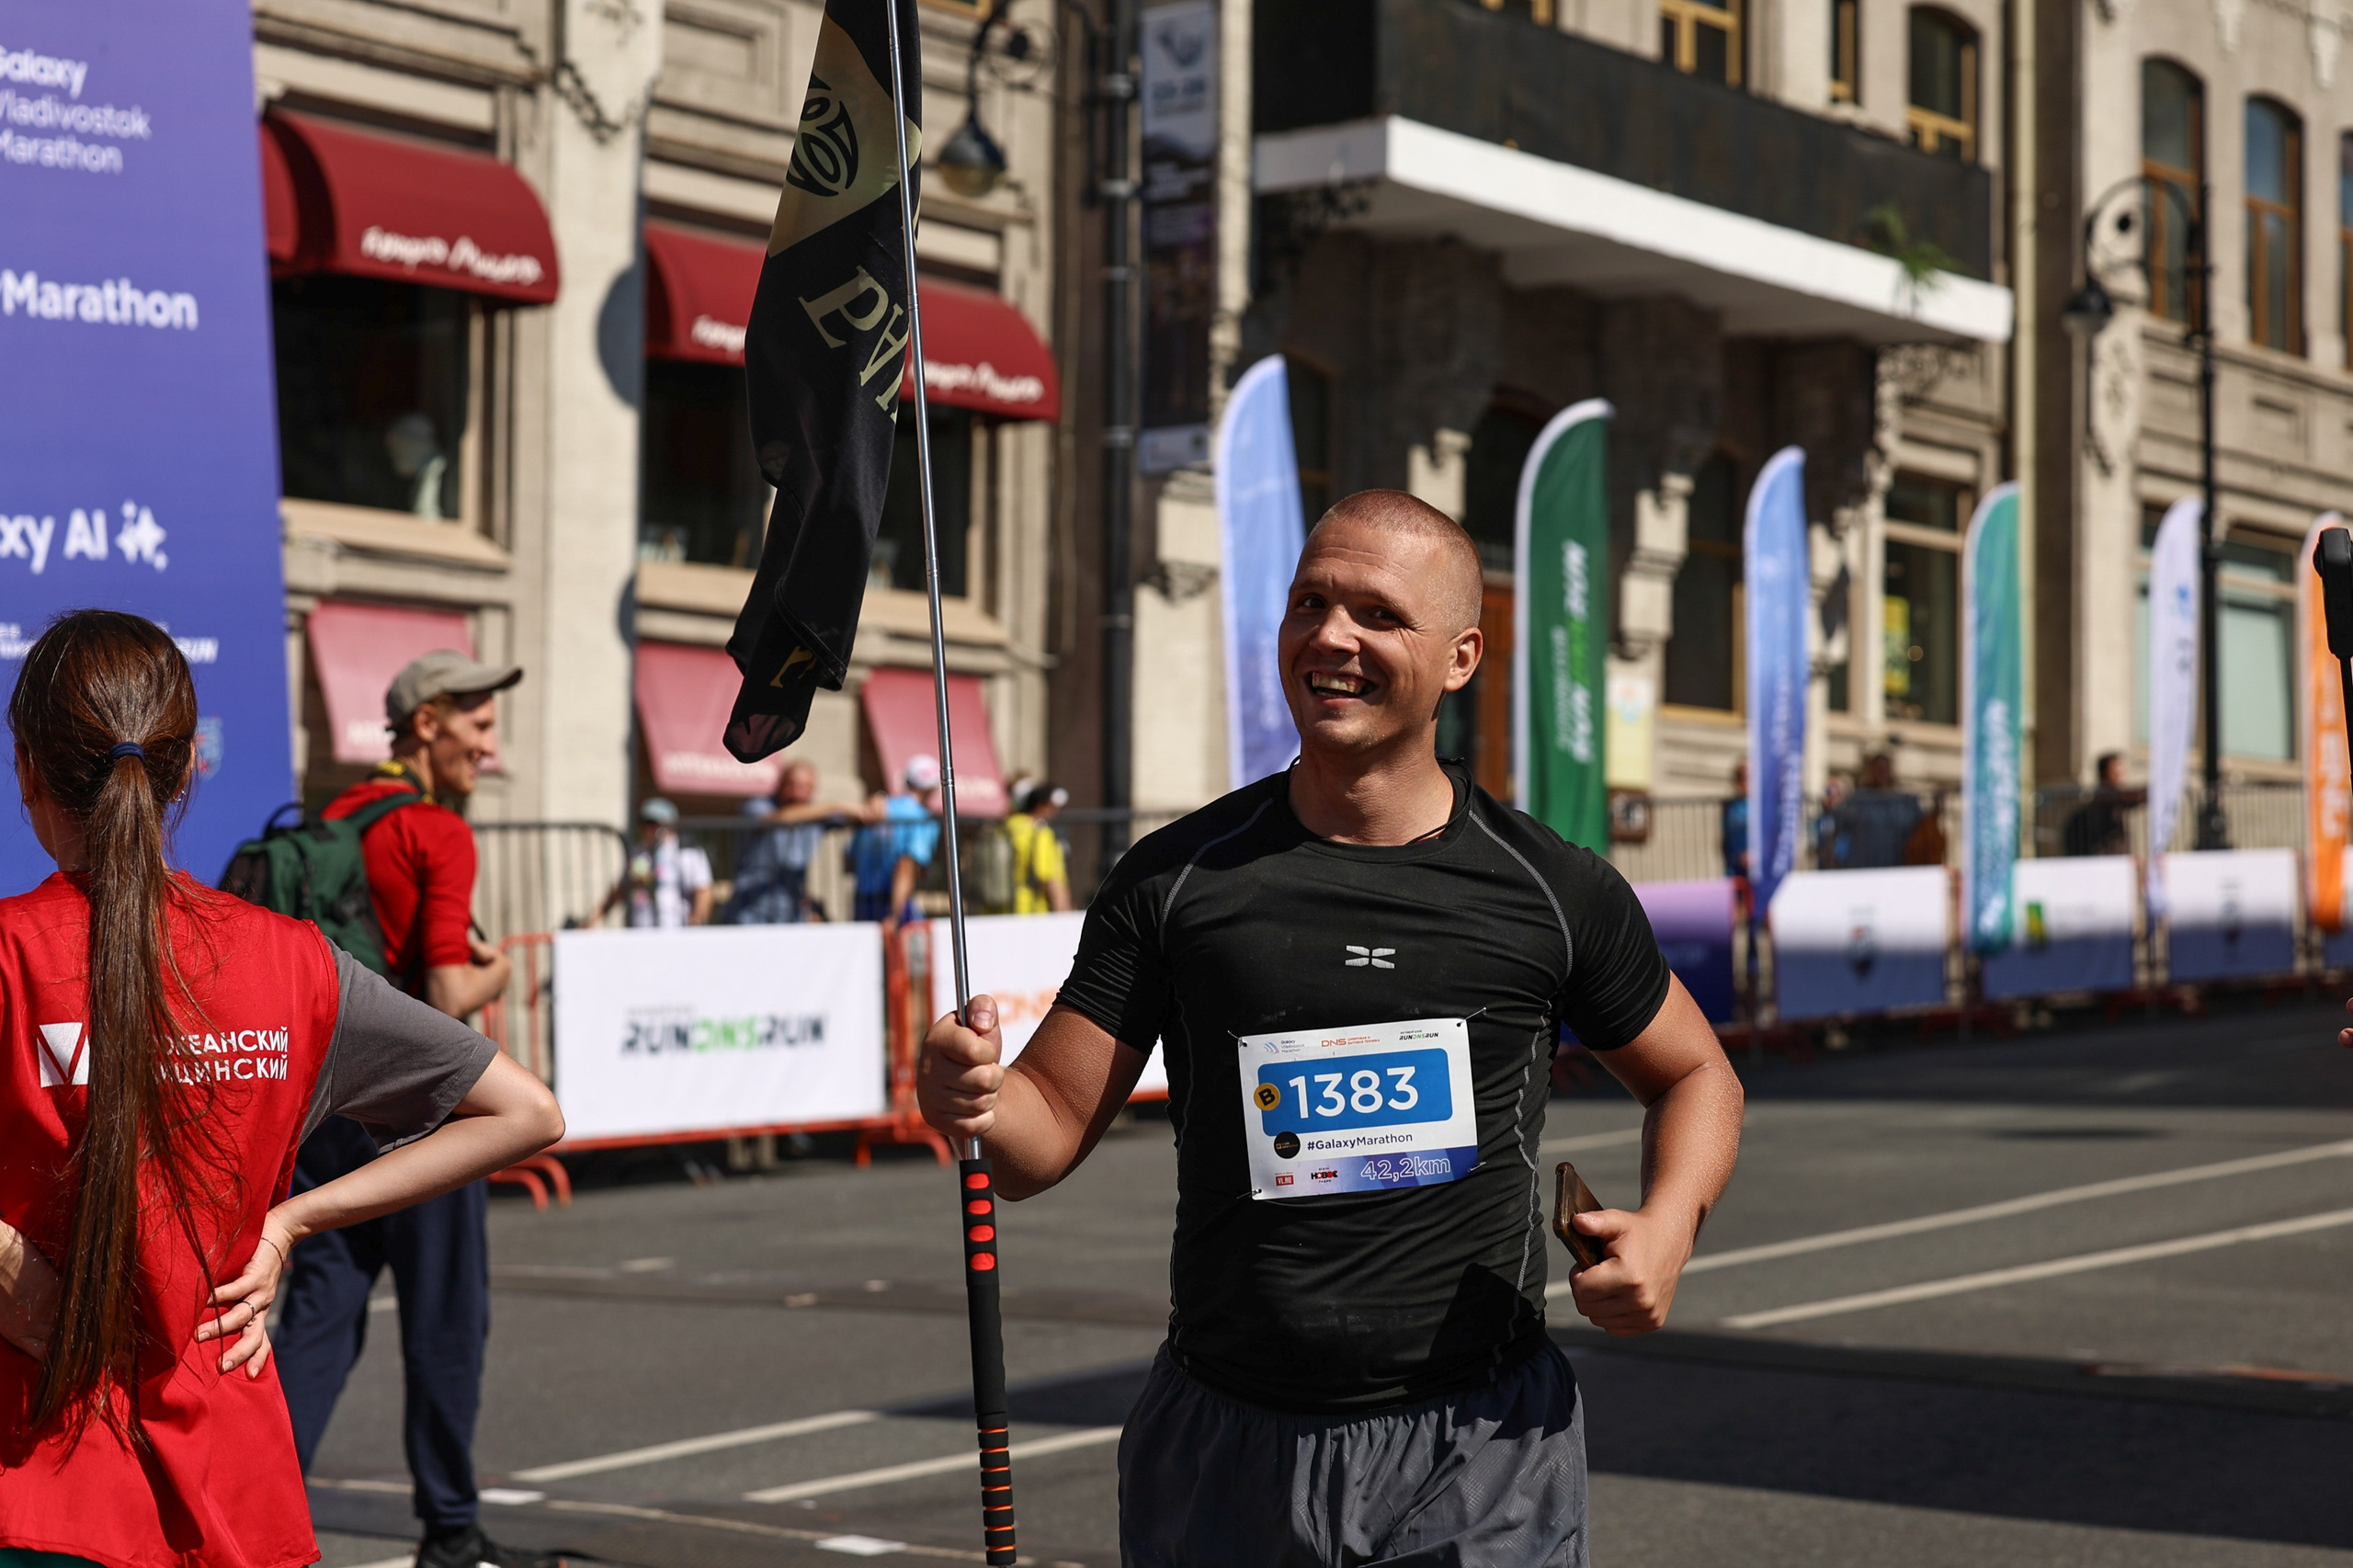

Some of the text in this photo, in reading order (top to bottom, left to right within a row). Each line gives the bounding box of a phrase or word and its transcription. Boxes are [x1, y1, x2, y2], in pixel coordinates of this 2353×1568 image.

[0, 268, 199, 330] Marathon
[1321, 1038, 1347, 1048] DNS
[1399, 1032, 1439, 1040] RUNDNSRUN
[1289, 1065, 1419, 1119] 1383
[1307, 1133, 1413, 1151] #GalaxyMarathon
[1360, 1155, 1451, 1183] 42,2km
